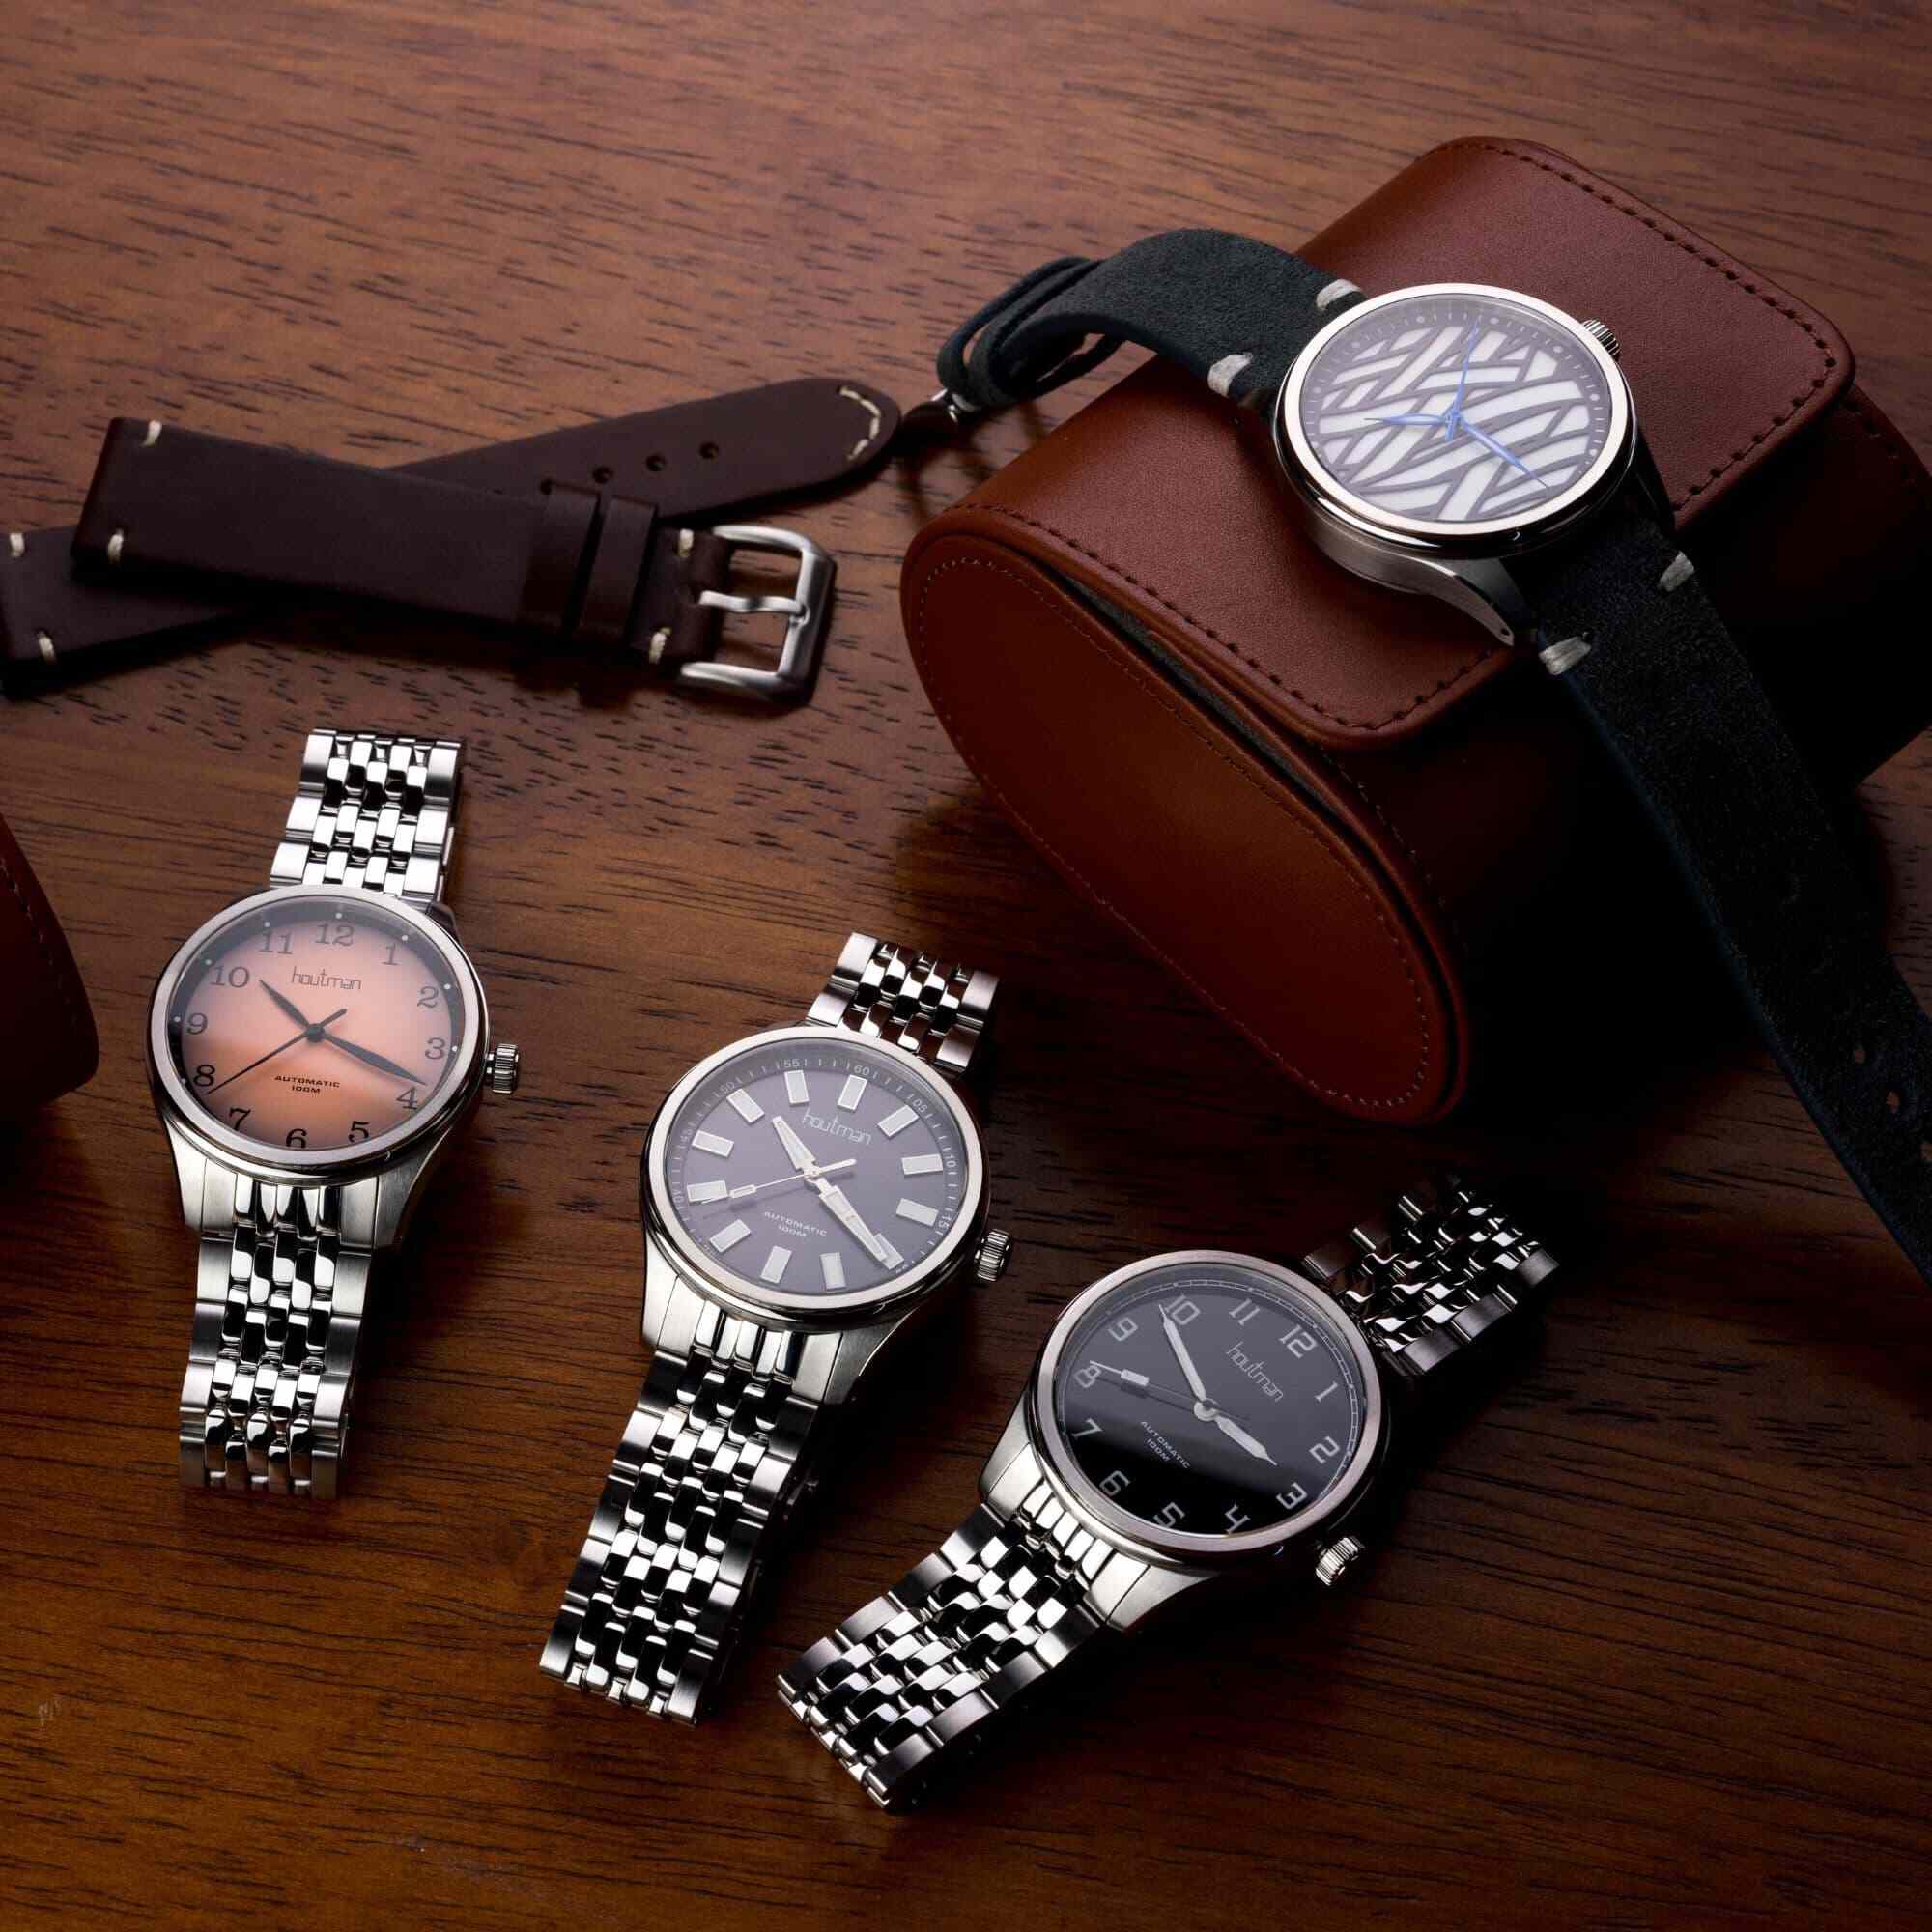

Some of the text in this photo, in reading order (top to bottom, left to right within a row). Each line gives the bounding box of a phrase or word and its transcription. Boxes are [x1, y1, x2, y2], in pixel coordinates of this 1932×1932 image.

[260, 933, 293, 954] 11
[315, 924, 355, 946] 12
[383, 946, 398, 966] 1
[210, 966, 250, 988] 10
[292, 966, 361, 990] houtman
[417, 986, 439, 1009] 2
[186, 1013, 207, 1035] 9
[425, 1038, 445, 1060] 3
[194, 1065, 215, 1087] 8
[274, 1075, 340, 1088] AUTOMATIC
[853, 1065, 870, 1076] 60
[292, 1086, 321, 1094] 100M
[397, 1087, 417, 1110] 4
[912, 1098, 928, 1113] 05
[229, 1109, 250, 1131] 7
[803, 1107, 872, 1145] houtman
[286, 1128, 306, 1149] 6
[349, 1121, 369, 1143] 5
[764, 1211, 828, 1236] AUTOMATIC
[1165, 1294, 1201, 1325] 10
[1229, 1298, 1262, 1326] 11
[1109, 1318, 1138, 1342] 9
[1279, 1326, 1317, 1358] 12
[1075, 1365, 1104, 1389] 8
[1226, 1342, 1284, 1402] houtman
[1316, 1382, 1338, 1403] 1
[1072, 1419, 1103, 1438] 7
[1141, 1421, 1191, 1469] AUTOMATIC
[1146, 1437, 1171, 1463] 100M
[1310, 1436, 1340, 1464] 2
[1100, 1470, 1130, 1496] 6
[1276, 1483, 1307, 1510] 3
[1154, 1503, 1186, 1528] 5
[1225, 1504, 1251, 1534] 4
